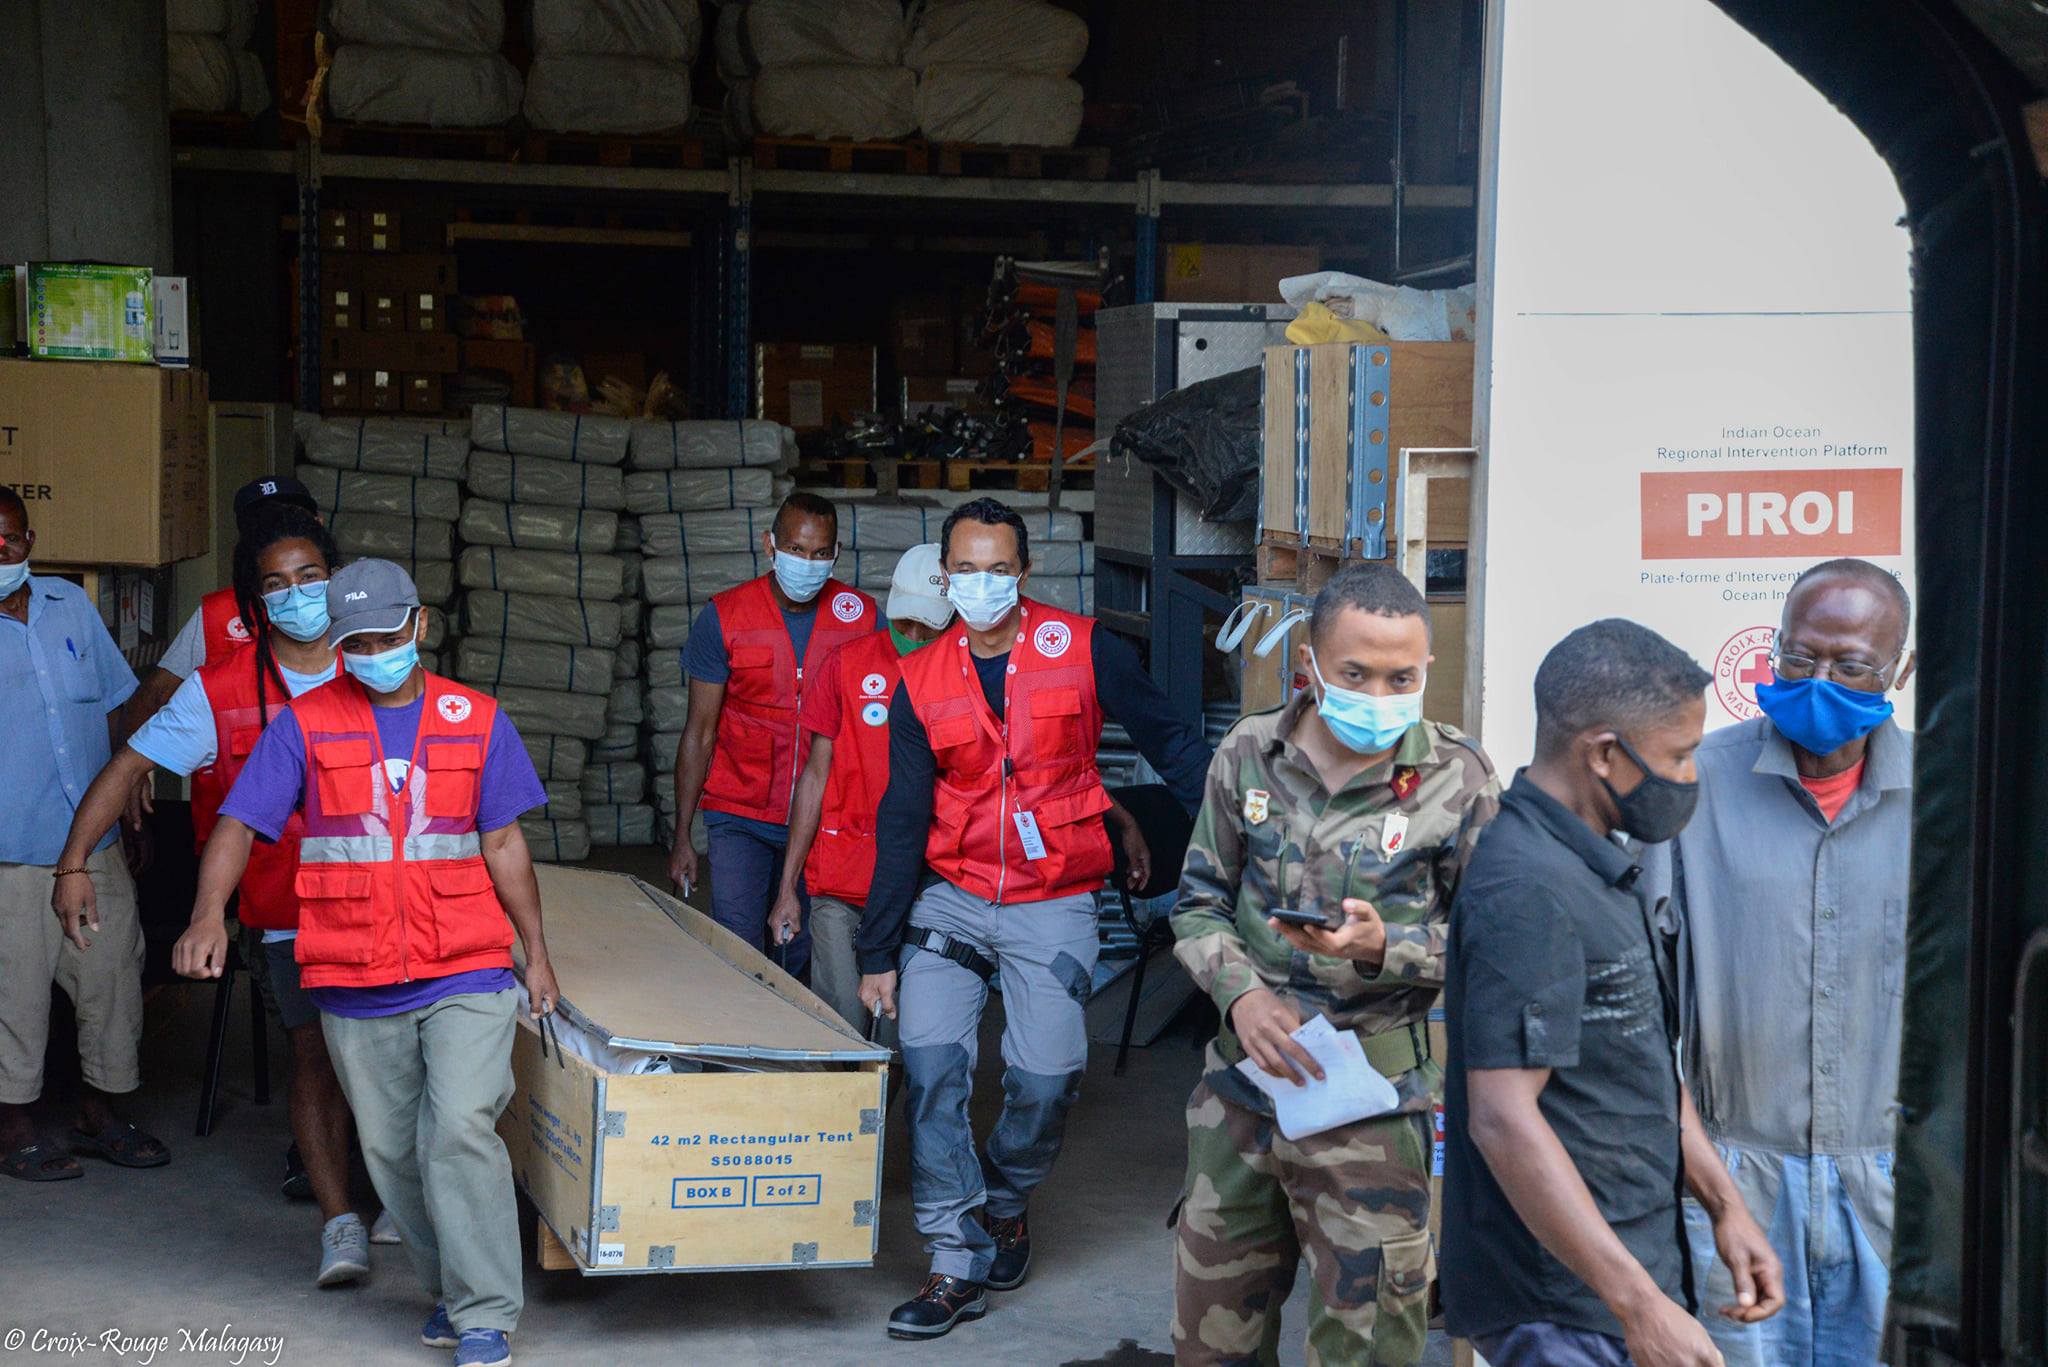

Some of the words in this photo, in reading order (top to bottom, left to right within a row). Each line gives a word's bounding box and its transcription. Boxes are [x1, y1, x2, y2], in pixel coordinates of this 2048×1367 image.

[1721, 427, 1768, 439] Indian
[1773, 426, 1821, 439] Ocean
[1657, 446, 1722, 462] Regional
[1727, 445, 1818, 459] Intervention
[1823, 443, 1888, 457] Platform
[8, 484, 52, 500] TER
[1687, 490, 1854, 537] PIROI
[1640, 571, 1720, 584] Plate-forme
[1725, 571, 1802, 582] d'Intervent
[345, 590, 369, 603] FILA
[1722, 589, 1767, 601] Ocean
[1720, 632, 1773, 678] CROIX-R
[650, 1135, 670, 1146] 42
[678, 1135, 702, 1146] m2
[709, 1132, 811, 1147] Rectangular
[817, 1131, 854, 1143] Tent
[711, 1154, 793, 1167] S5088015
[686, 1187, 718, 1199] BOX
[721, 1187, 732, 1198] B
[766, 1185, 775, 1197] 2
[778, 1184, 793, 1197] of
[797, 1184, 807, 1196] 2
